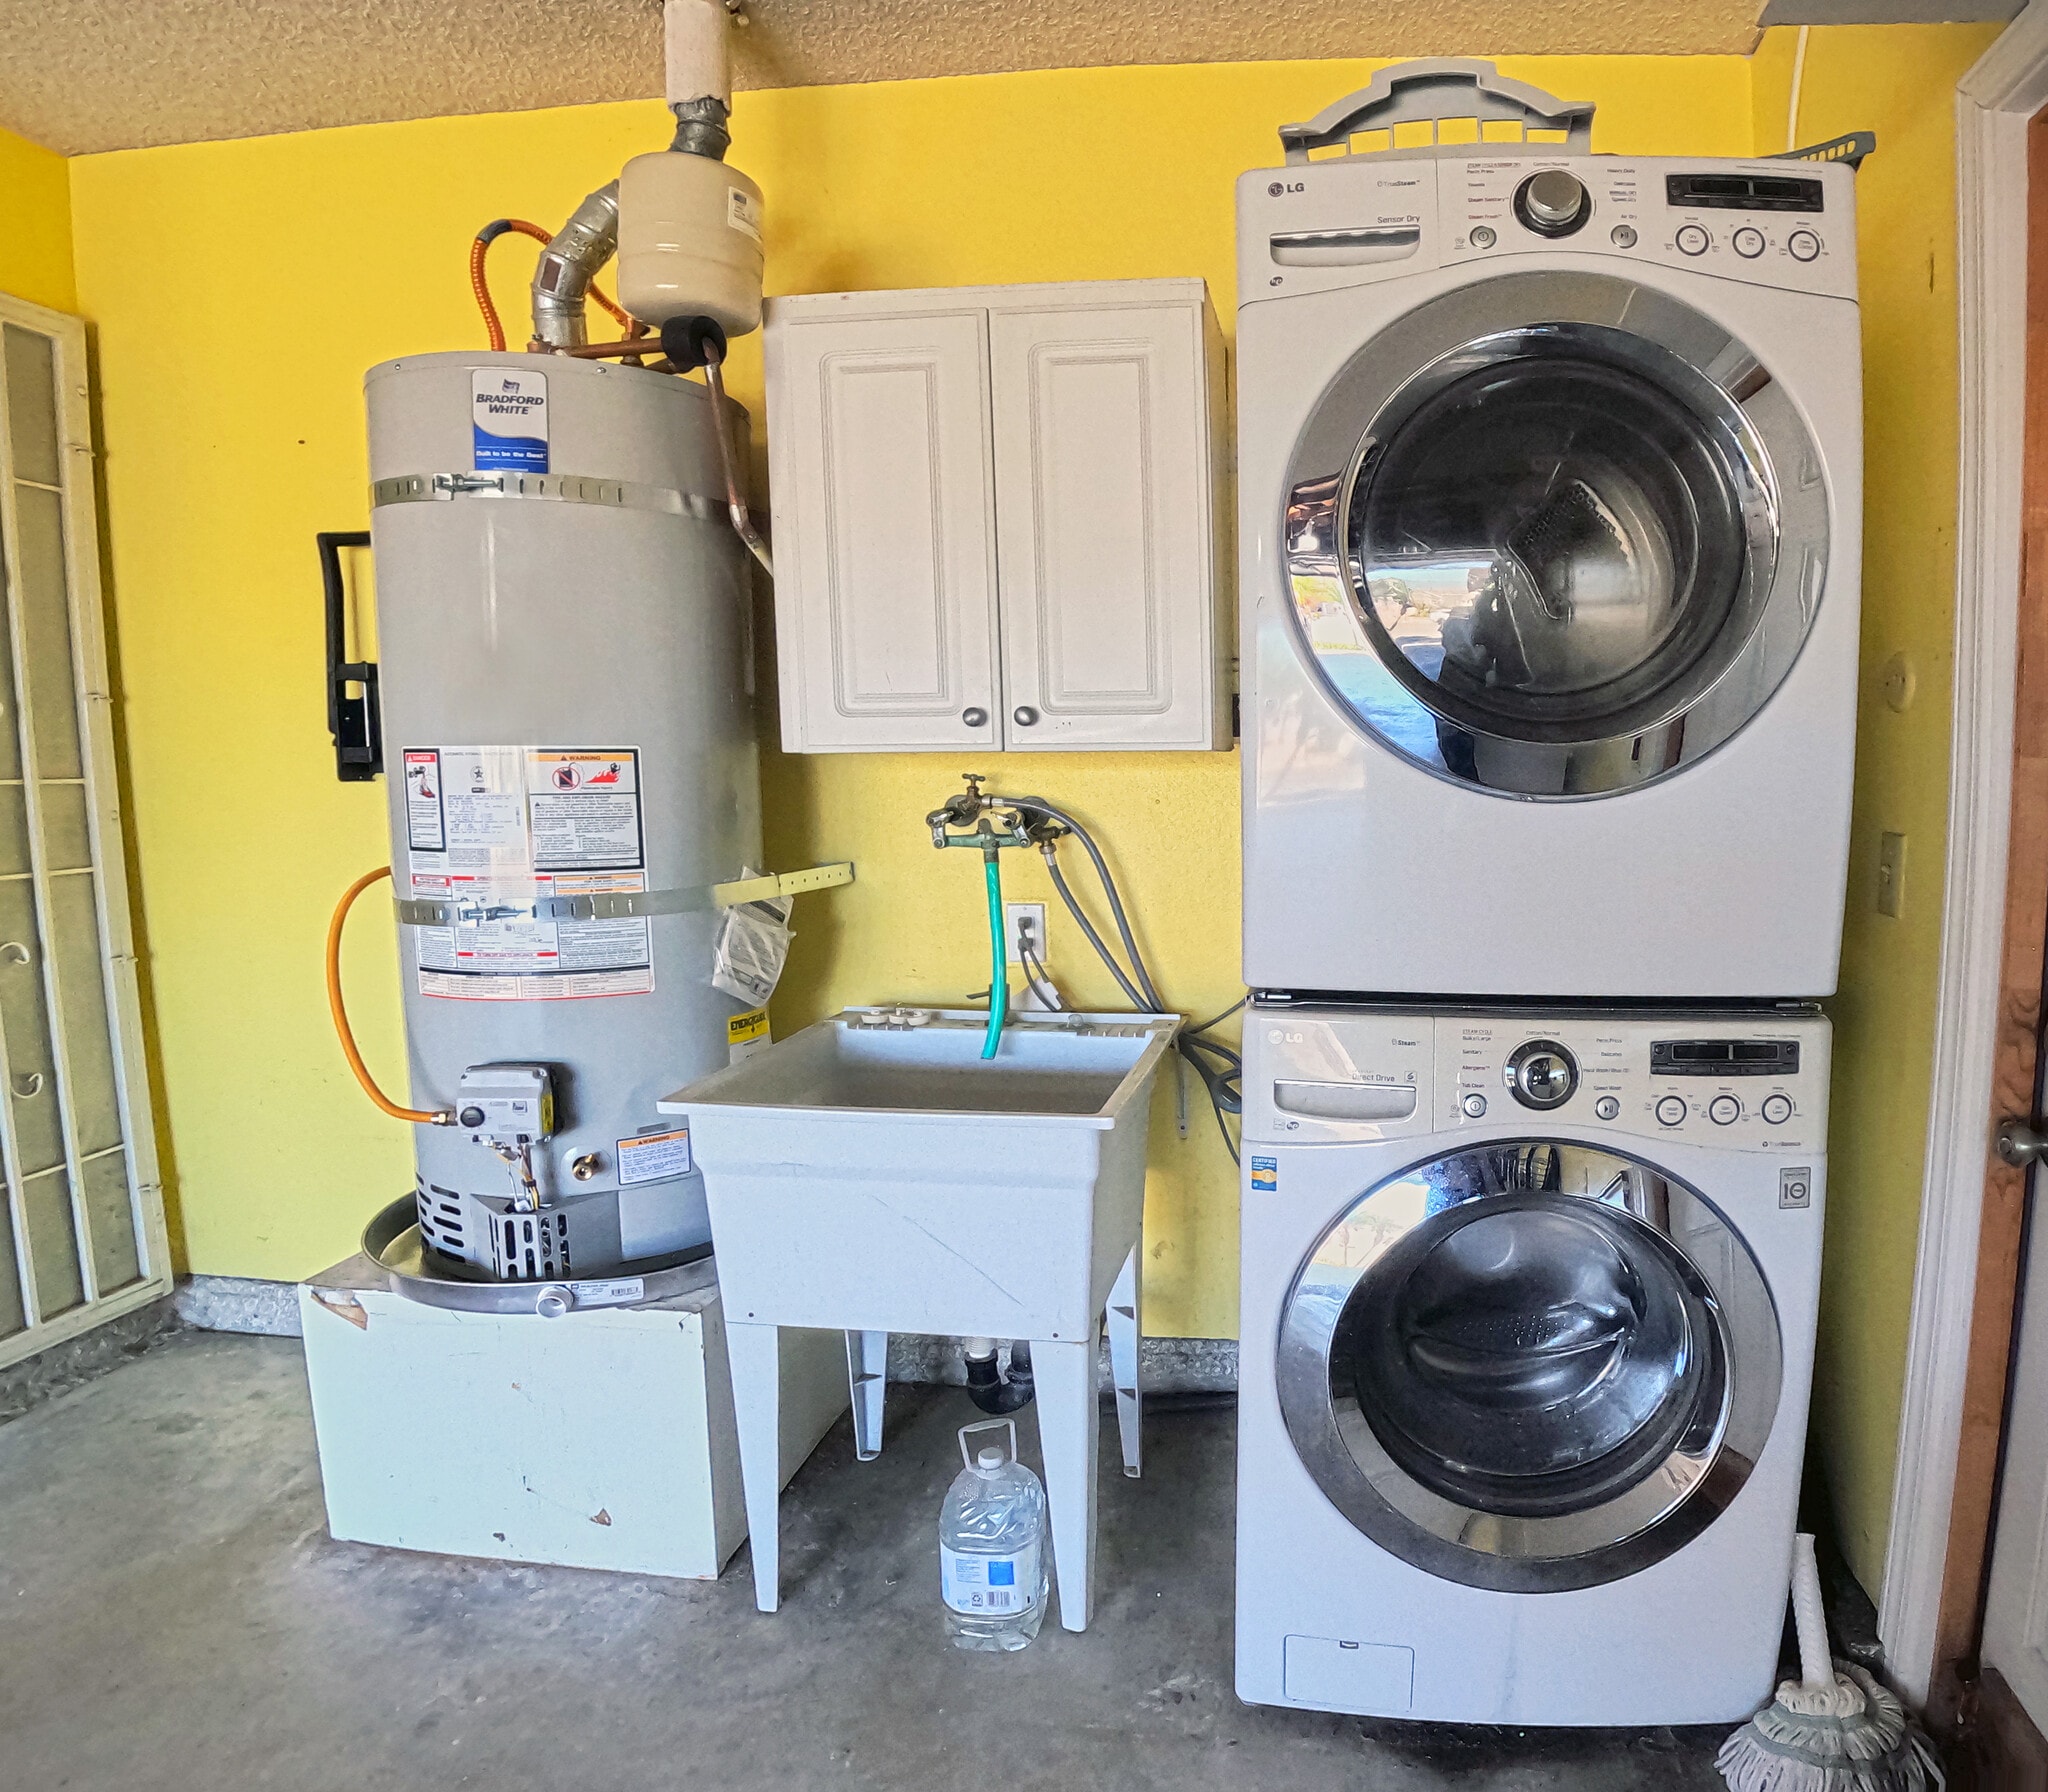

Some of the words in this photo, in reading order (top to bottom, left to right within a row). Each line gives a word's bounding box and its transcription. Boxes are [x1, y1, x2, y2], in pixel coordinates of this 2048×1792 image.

[1287, 182, 1305, 193] LG
[1377, 216, 1405, 224] Sensor
[1406, 214, 1421, 223] Dry
[476, 393, 545, 406] BRADFORD
[488, 403, 530, 415] WHITE
[1285, 1032, 1304, 1044] LG
[1375, 1074, 1396, 1082] Drive
[643, 1135, 671, 1144] WARNING
